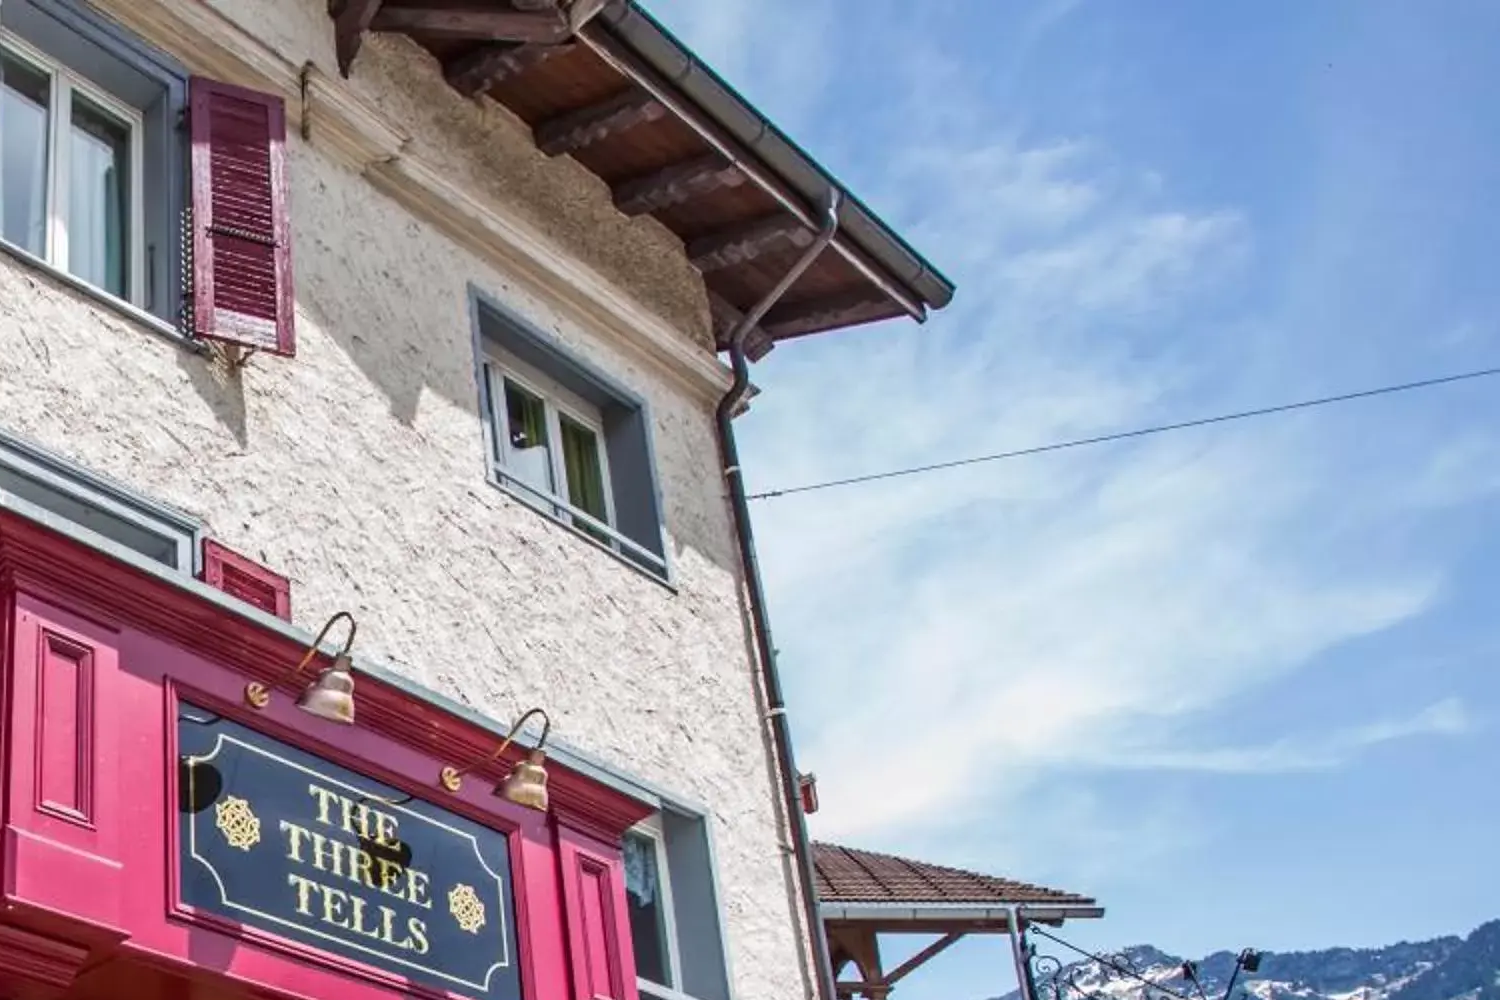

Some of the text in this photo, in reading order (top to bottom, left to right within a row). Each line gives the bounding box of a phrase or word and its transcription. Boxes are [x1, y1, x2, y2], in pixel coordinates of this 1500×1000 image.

[309, 783, 402, 852] THE
[279, 819, 433, 909] THREE
[288, 873, 429, 956] TELLS
